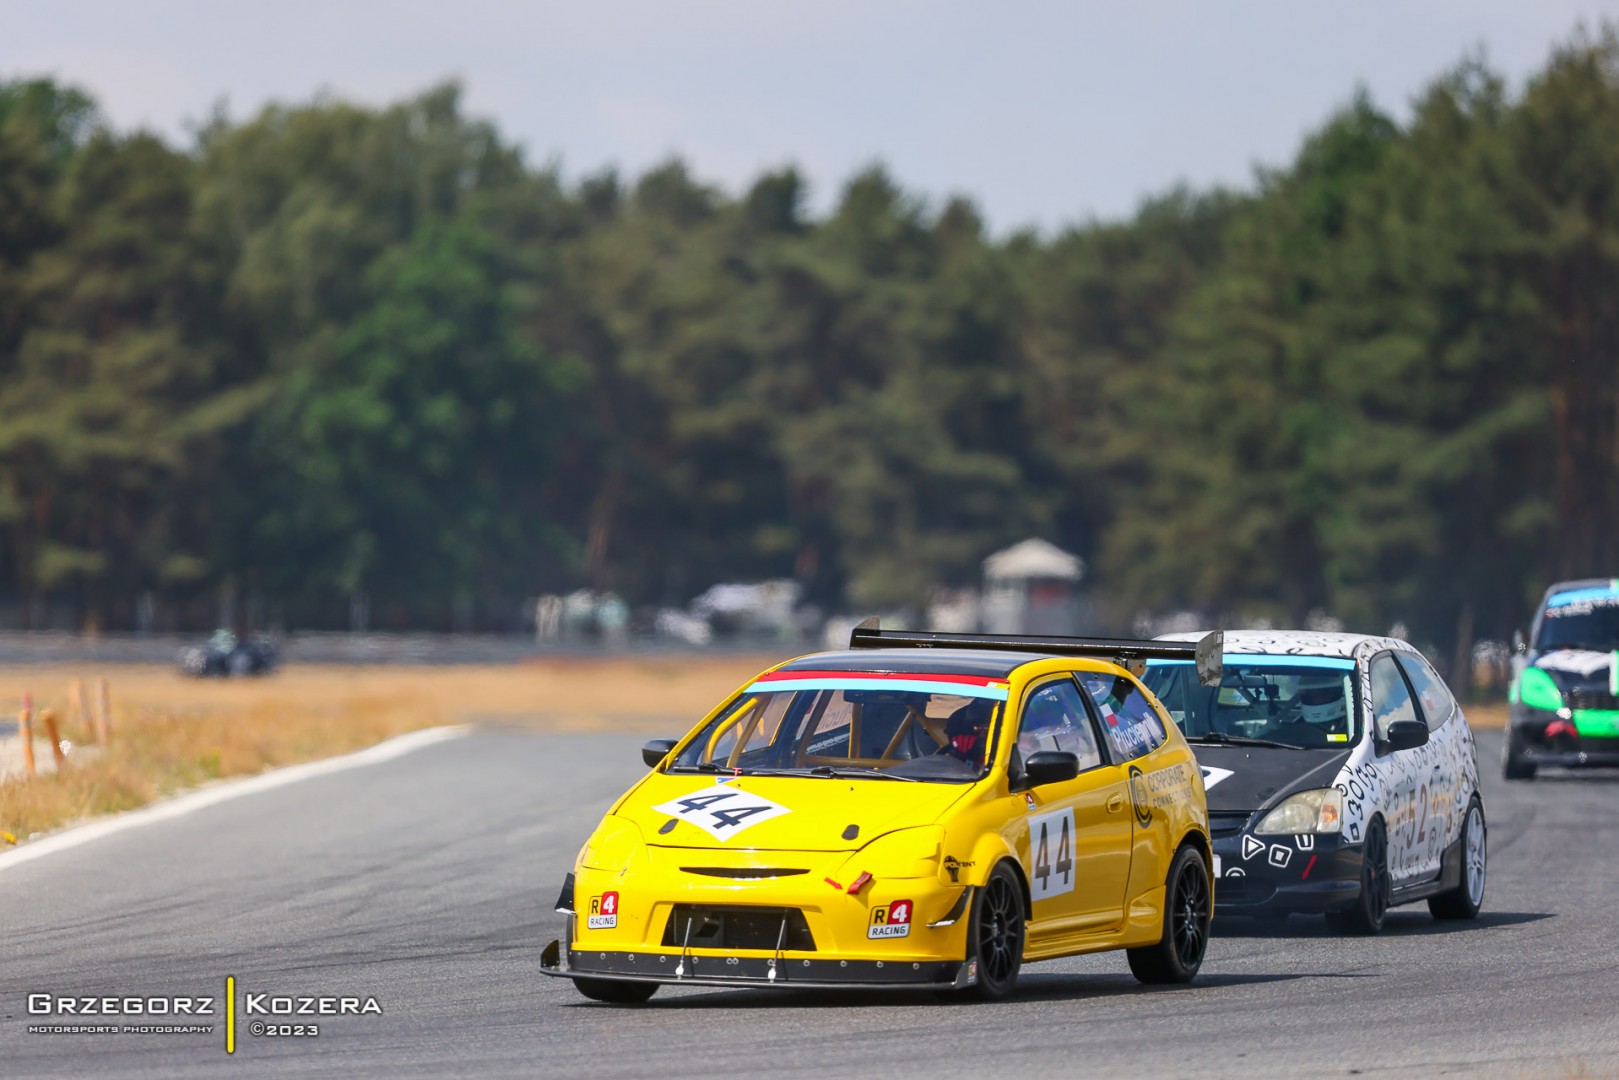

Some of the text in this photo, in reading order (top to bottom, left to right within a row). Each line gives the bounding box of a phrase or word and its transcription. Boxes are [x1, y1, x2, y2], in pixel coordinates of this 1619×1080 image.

[1148, 765, 1187, 792] CORPORATE
[677, 793, 773, 829] 44
[1406, 783, 1428, 849] 52
[1035, 816, 1072, 891] 44
[590, 917, 614, 926] RACING
[872, 926, 906, 936] RACING
